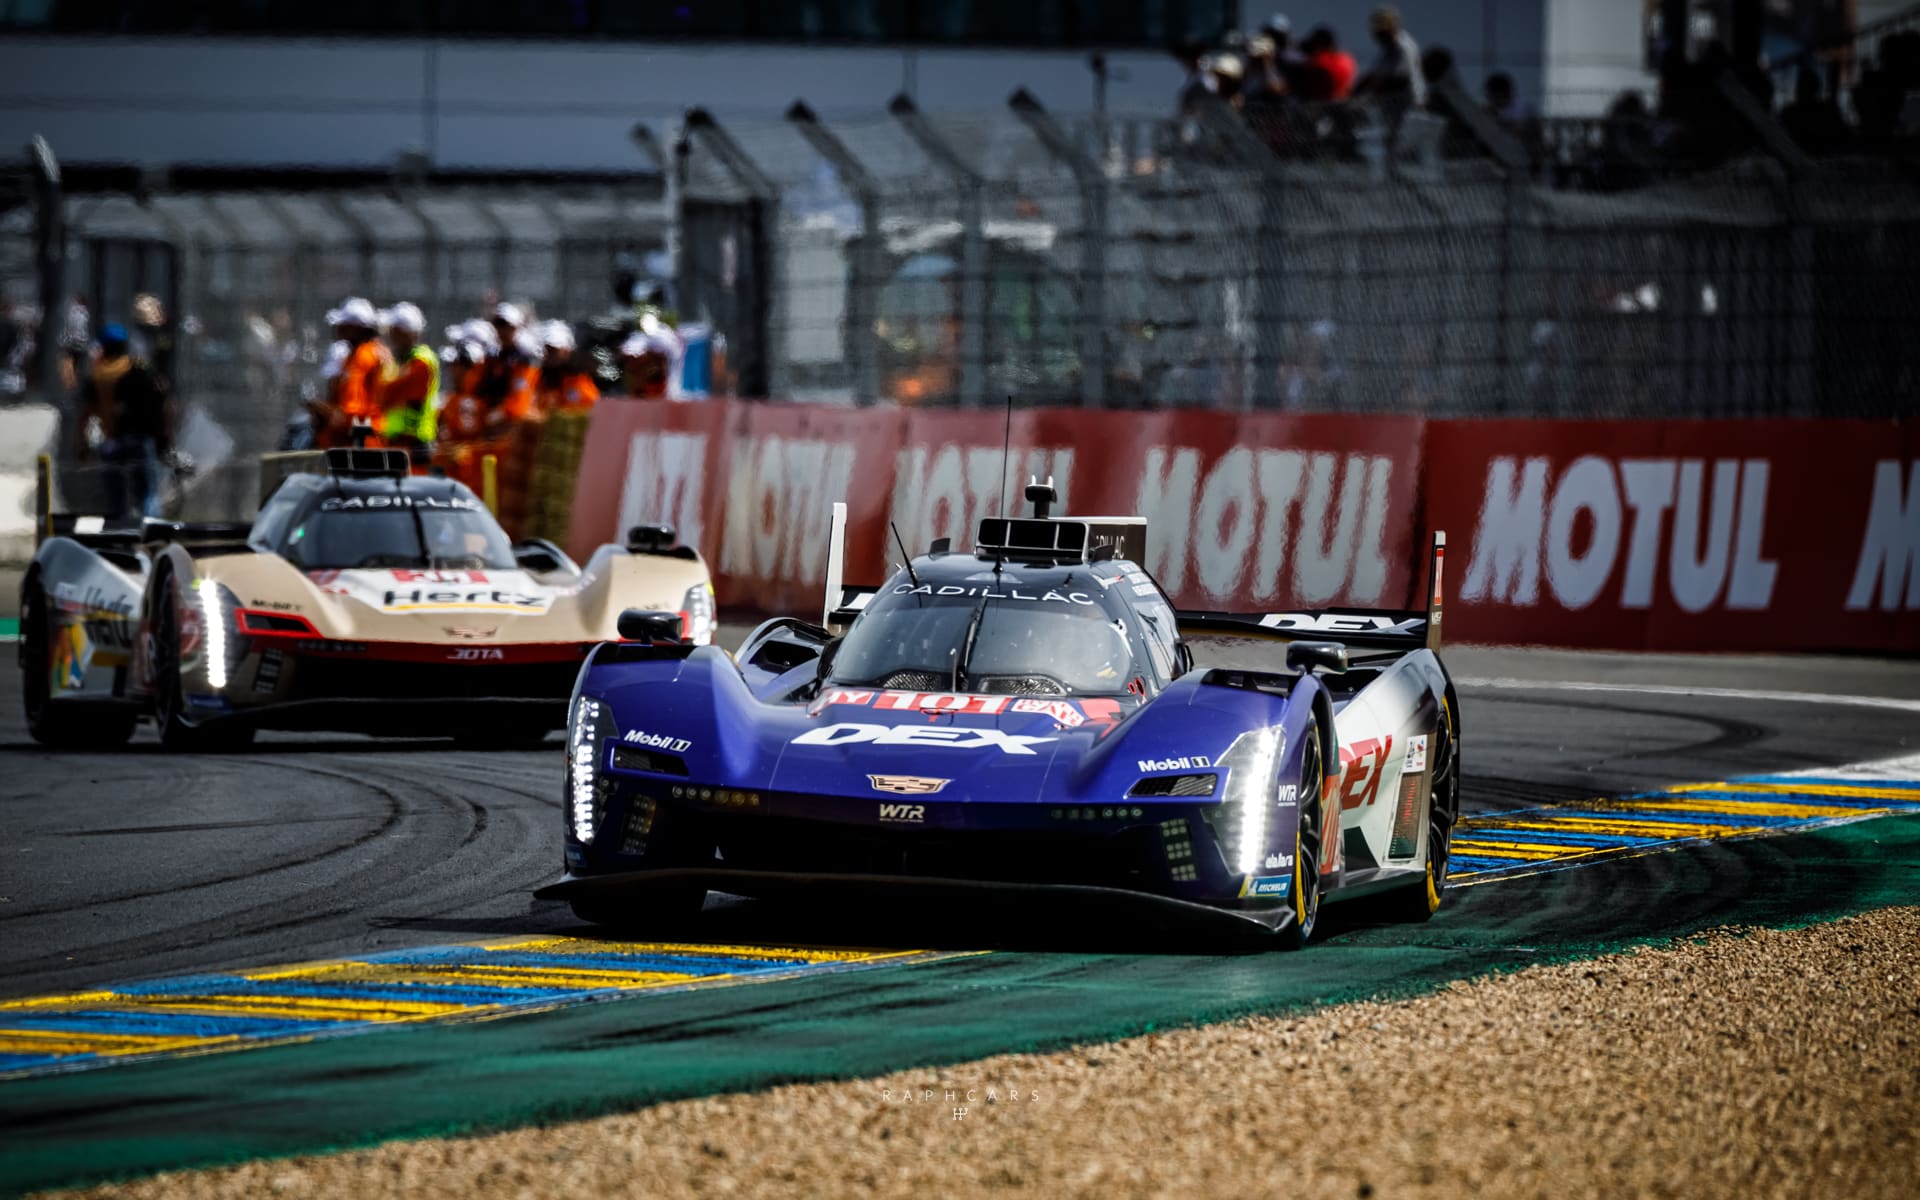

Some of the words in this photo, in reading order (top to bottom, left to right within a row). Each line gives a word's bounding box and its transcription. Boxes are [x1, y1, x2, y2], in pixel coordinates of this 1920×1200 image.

[1137, 444, 1392, 604] MOTUL
[1460, 455, 1778, 613] MOTUL
[384, 590, 546, 605] Hertz
[893, 583, 1095, 606] CADILLAC
[447, 648, 504, 661] JOTA
[624, 729, 671, 750] Mobil
[789, 723, 1059, 754] DEX
[1138, 757, 1191, 772] Mobil
[1278, 785, 1297, 801] WTR
[880, 803, 925, 819] WTR
